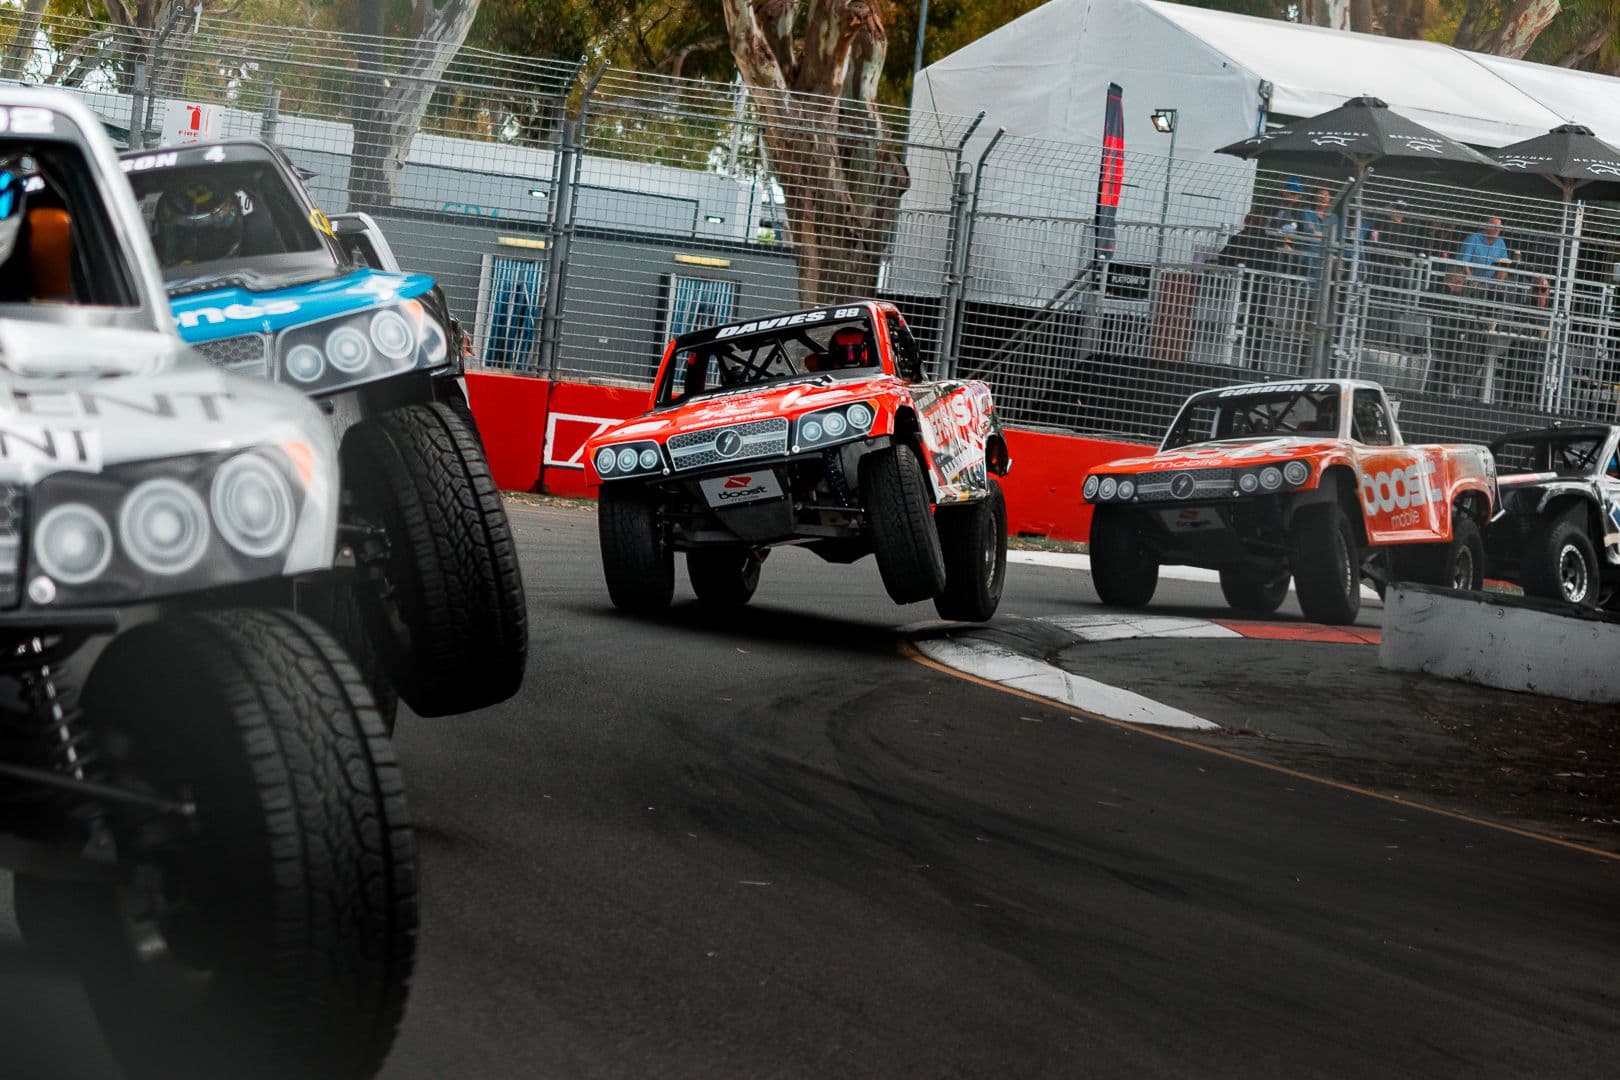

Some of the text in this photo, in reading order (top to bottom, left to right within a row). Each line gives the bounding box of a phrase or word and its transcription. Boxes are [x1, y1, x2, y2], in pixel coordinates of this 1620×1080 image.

[204, 146, 226, 163] 4
[715, 308, 860, 339] DAVIES 88
[1219, 384, 1308, 397] GORDON
[1152, 458, 1223, 469] mobile
[718, 486, 768, 499] boost
[1391, 511, 1420, 529] mobile
